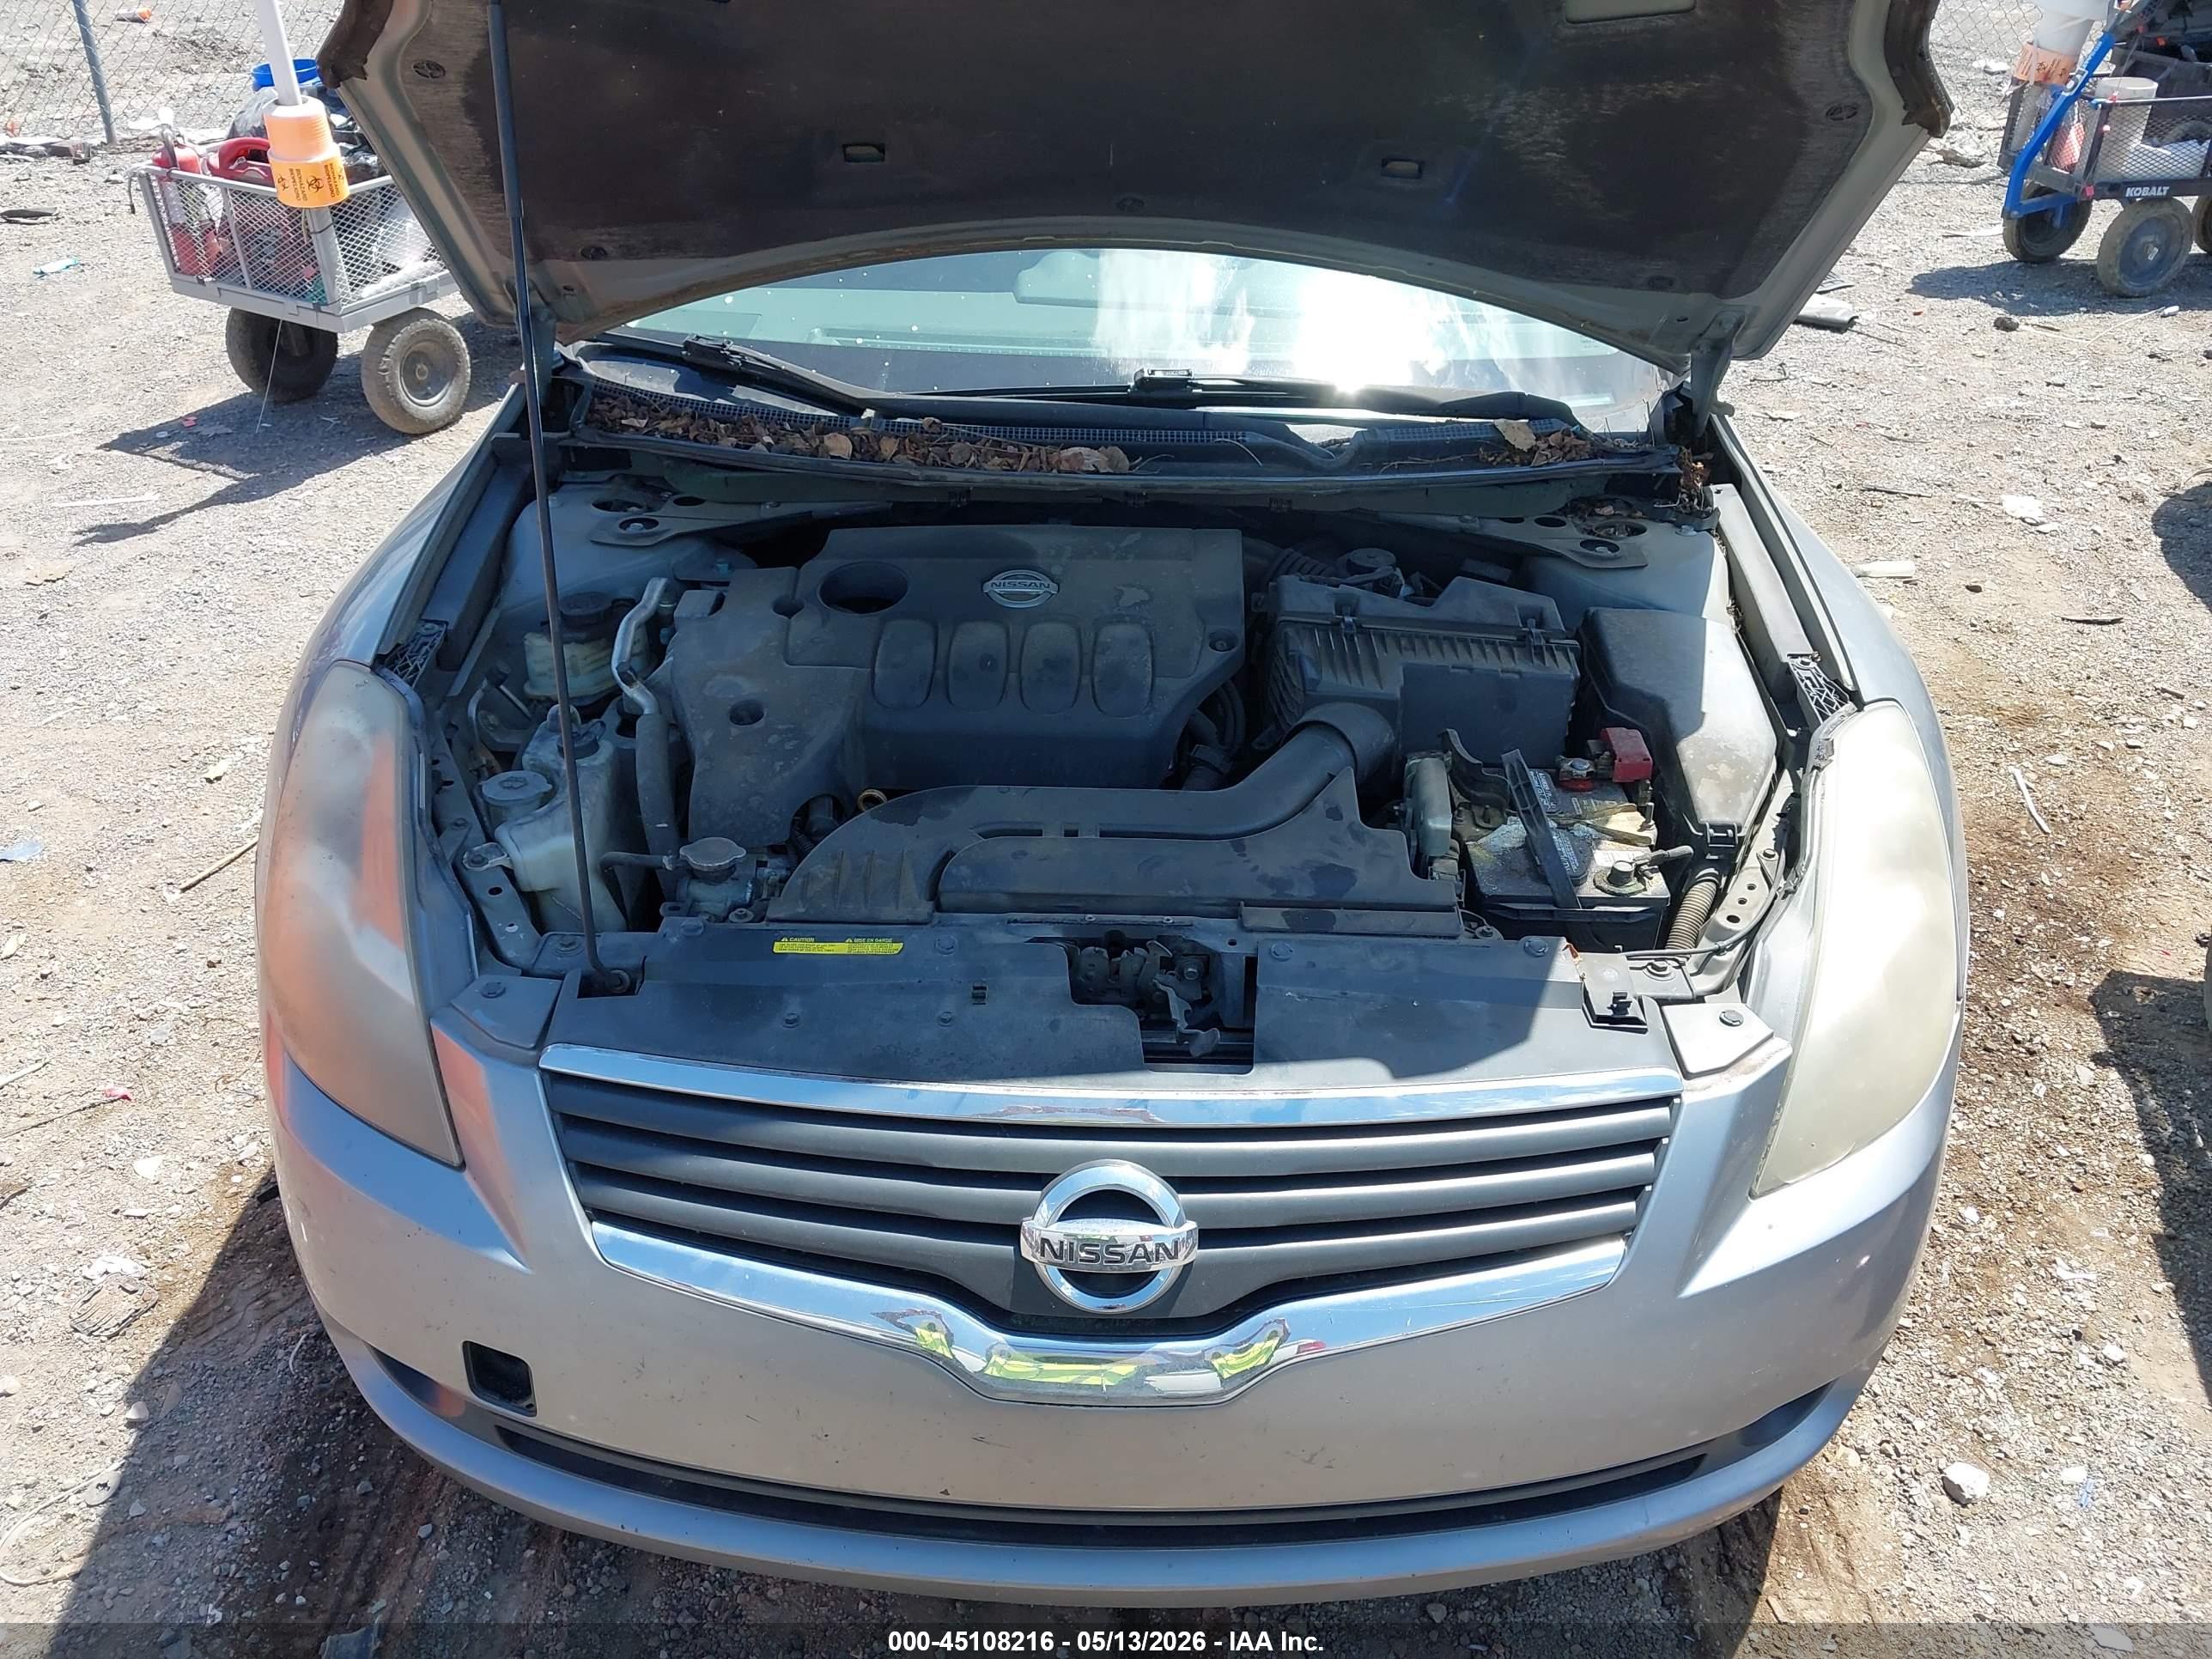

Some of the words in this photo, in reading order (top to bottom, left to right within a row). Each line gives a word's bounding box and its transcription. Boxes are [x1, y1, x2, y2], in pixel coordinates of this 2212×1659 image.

[2125, 185, 2170, 197] KOBALT
[990, 580, 1051, 589] NISSAN
[1039, 1237, 1180, 1267] NISSAN
